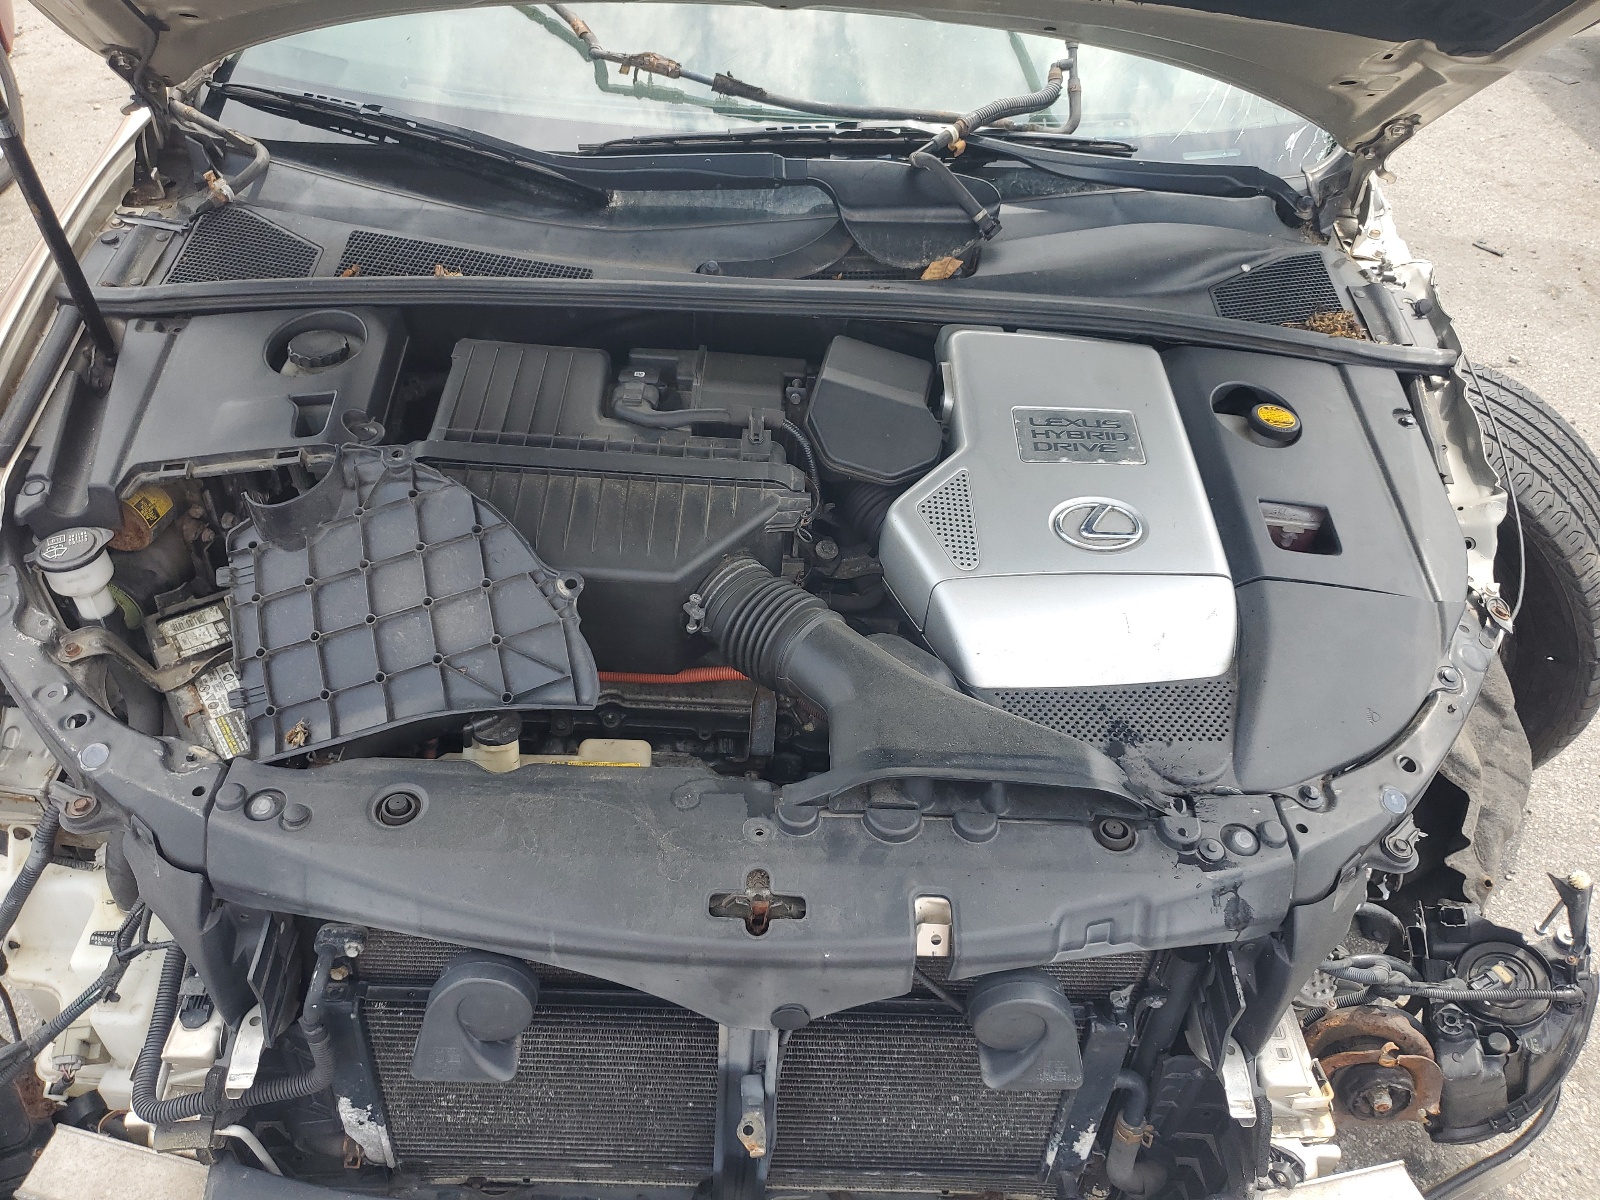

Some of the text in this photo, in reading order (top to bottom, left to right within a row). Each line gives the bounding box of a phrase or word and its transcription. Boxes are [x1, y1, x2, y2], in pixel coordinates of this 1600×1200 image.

[1029, 417, 1122, 429] LEXUS
[1031, 430, 1129, 441] HYBRID
[1033, 442, 1118, 453] DRIVE
